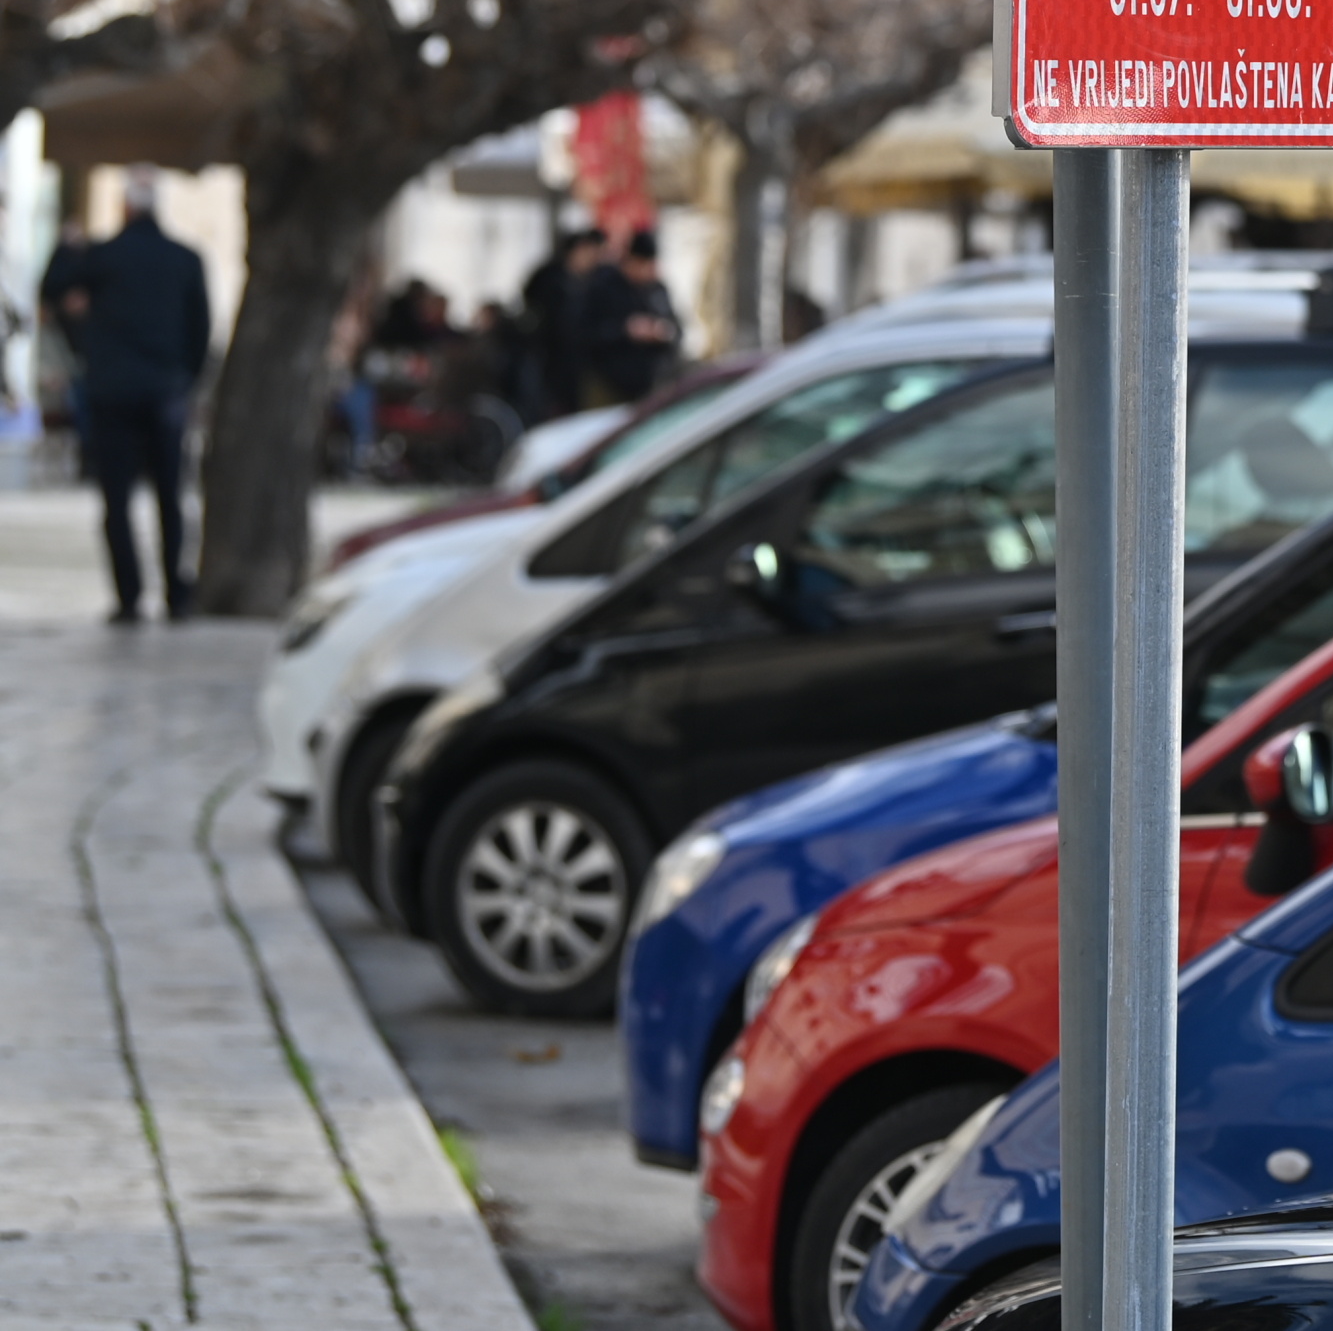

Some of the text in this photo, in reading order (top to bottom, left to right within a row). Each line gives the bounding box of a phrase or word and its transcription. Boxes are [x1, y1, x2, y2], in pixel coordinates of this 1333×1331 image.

[1033, 59, 1059, 108] NE
[1069, 59, 1155, 108] VRIJEDI
[1163, 49, 1301, 109] POVLAŠTENA
